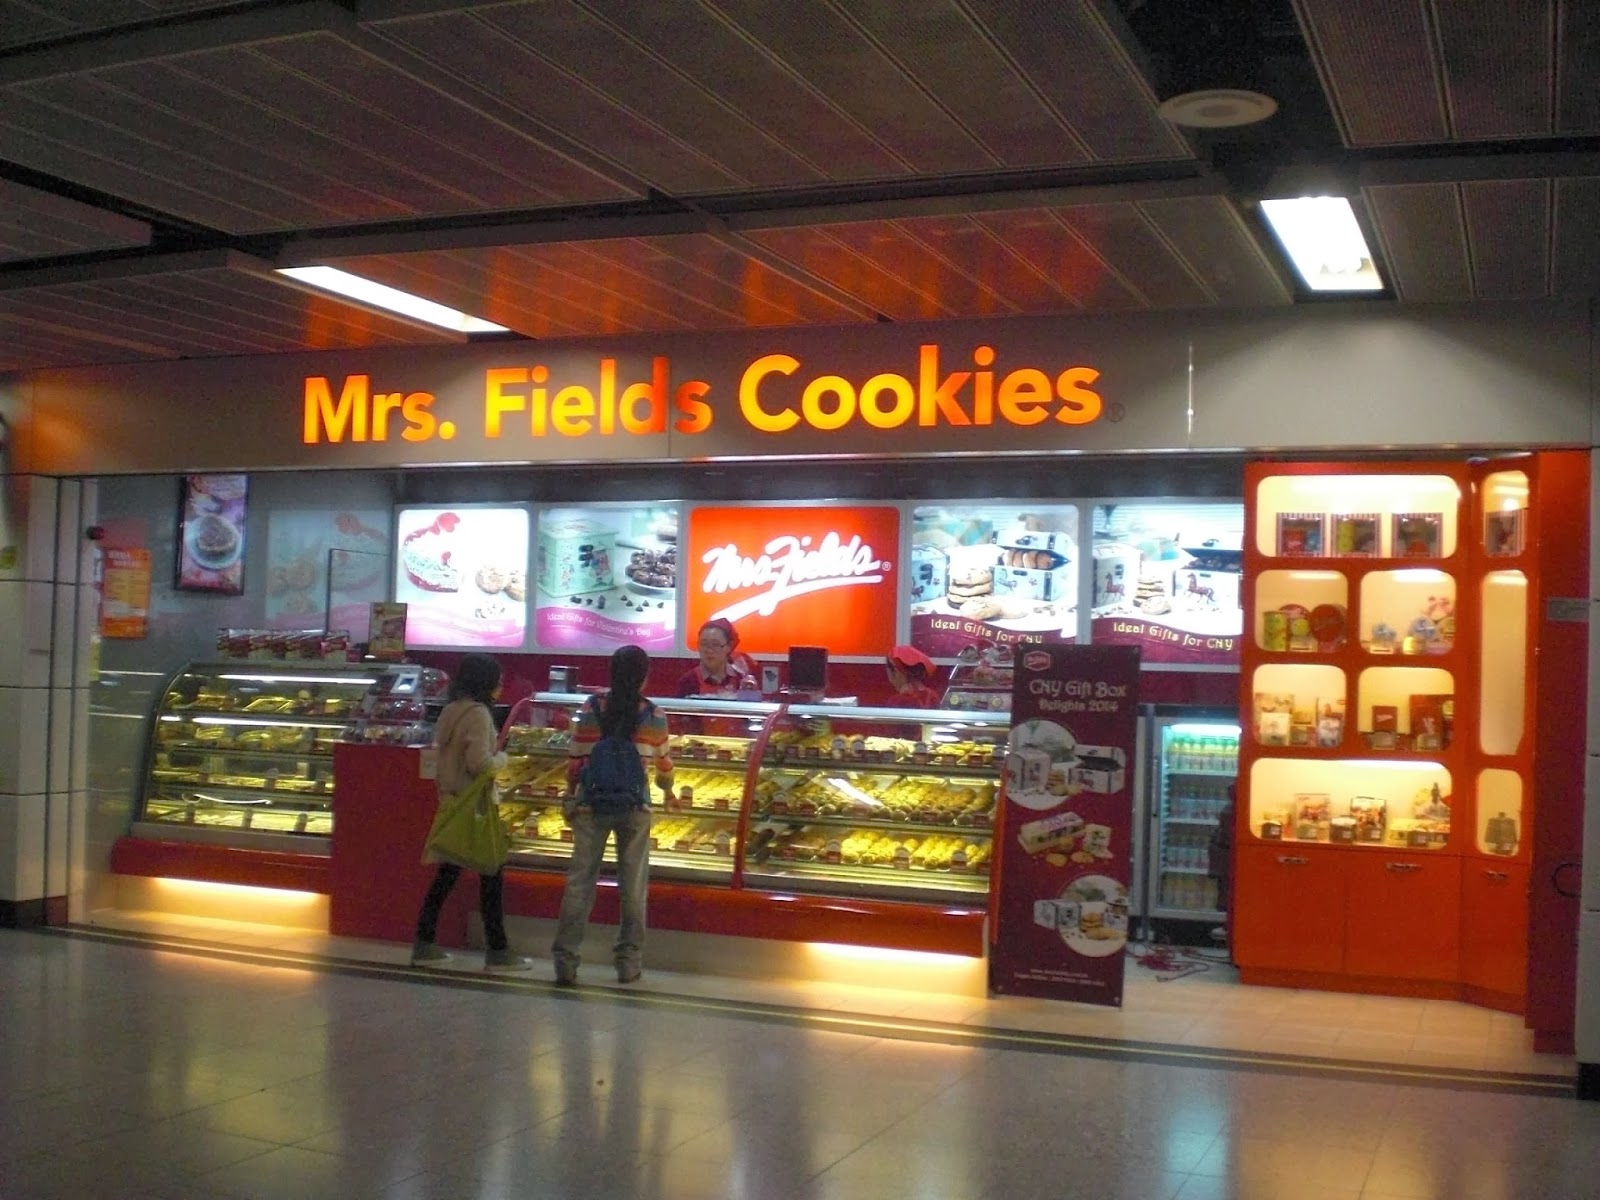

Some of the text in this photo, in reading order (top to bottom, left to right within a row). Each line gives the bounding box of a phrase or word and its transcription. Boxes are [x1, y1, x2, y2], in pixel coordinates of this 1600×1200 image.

[303, 344, 1102, 445] Mrs. Fields Cookies
[931, 619, 960, 630] Ideal
[964, 621, 992, 637] Gifts
[995, 630, 1015, 642] for
[1113, 622, 1233, 651] Ideal Gifts for CNY
[1029, 679, 1126, 699] CNY Gift Box
[1088, 700, 1119, 713] 2014
